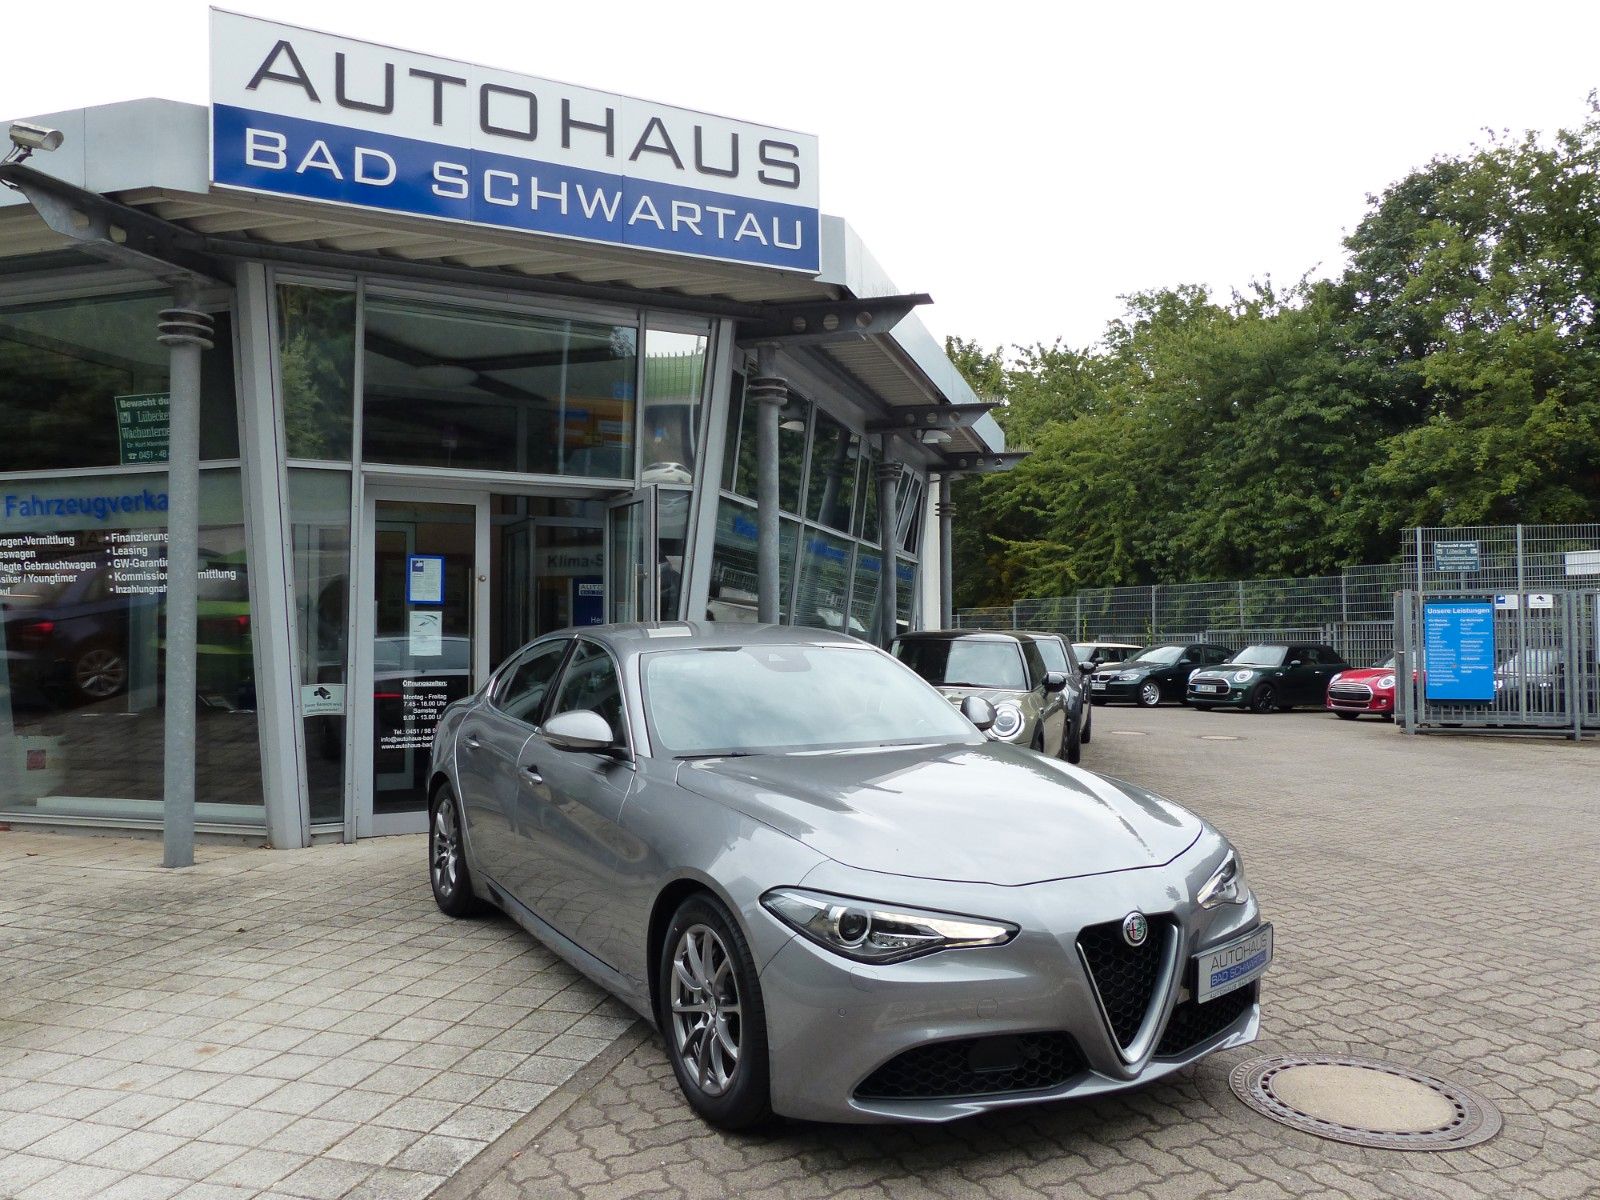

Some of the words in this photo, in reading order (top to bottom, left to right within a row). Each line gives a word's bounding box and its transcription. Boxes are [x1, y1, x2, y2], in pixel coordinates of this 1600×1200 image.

[244, 39, 802, 190] AUTOHAUS
[245, 127, 398, 187] BAD
[430, 160, 803, 251] SCHWARTAU
[120, 397, 156, 408] Bewacht
[5, 489, 168, 520] Fahrzeugverka
[111, 532, 168, 543] Finanzierung
[112, 546, 148, 556] Leasing
[24, 561, 96, 571] Gebrauchtwagen
[0, 574, 21, 583] siker
[28, 573, 77, 585] Youngtimer
[1211, 933, 1267, 972] AUTOHAUS
[1212, 972, 1229, 987] BAD
